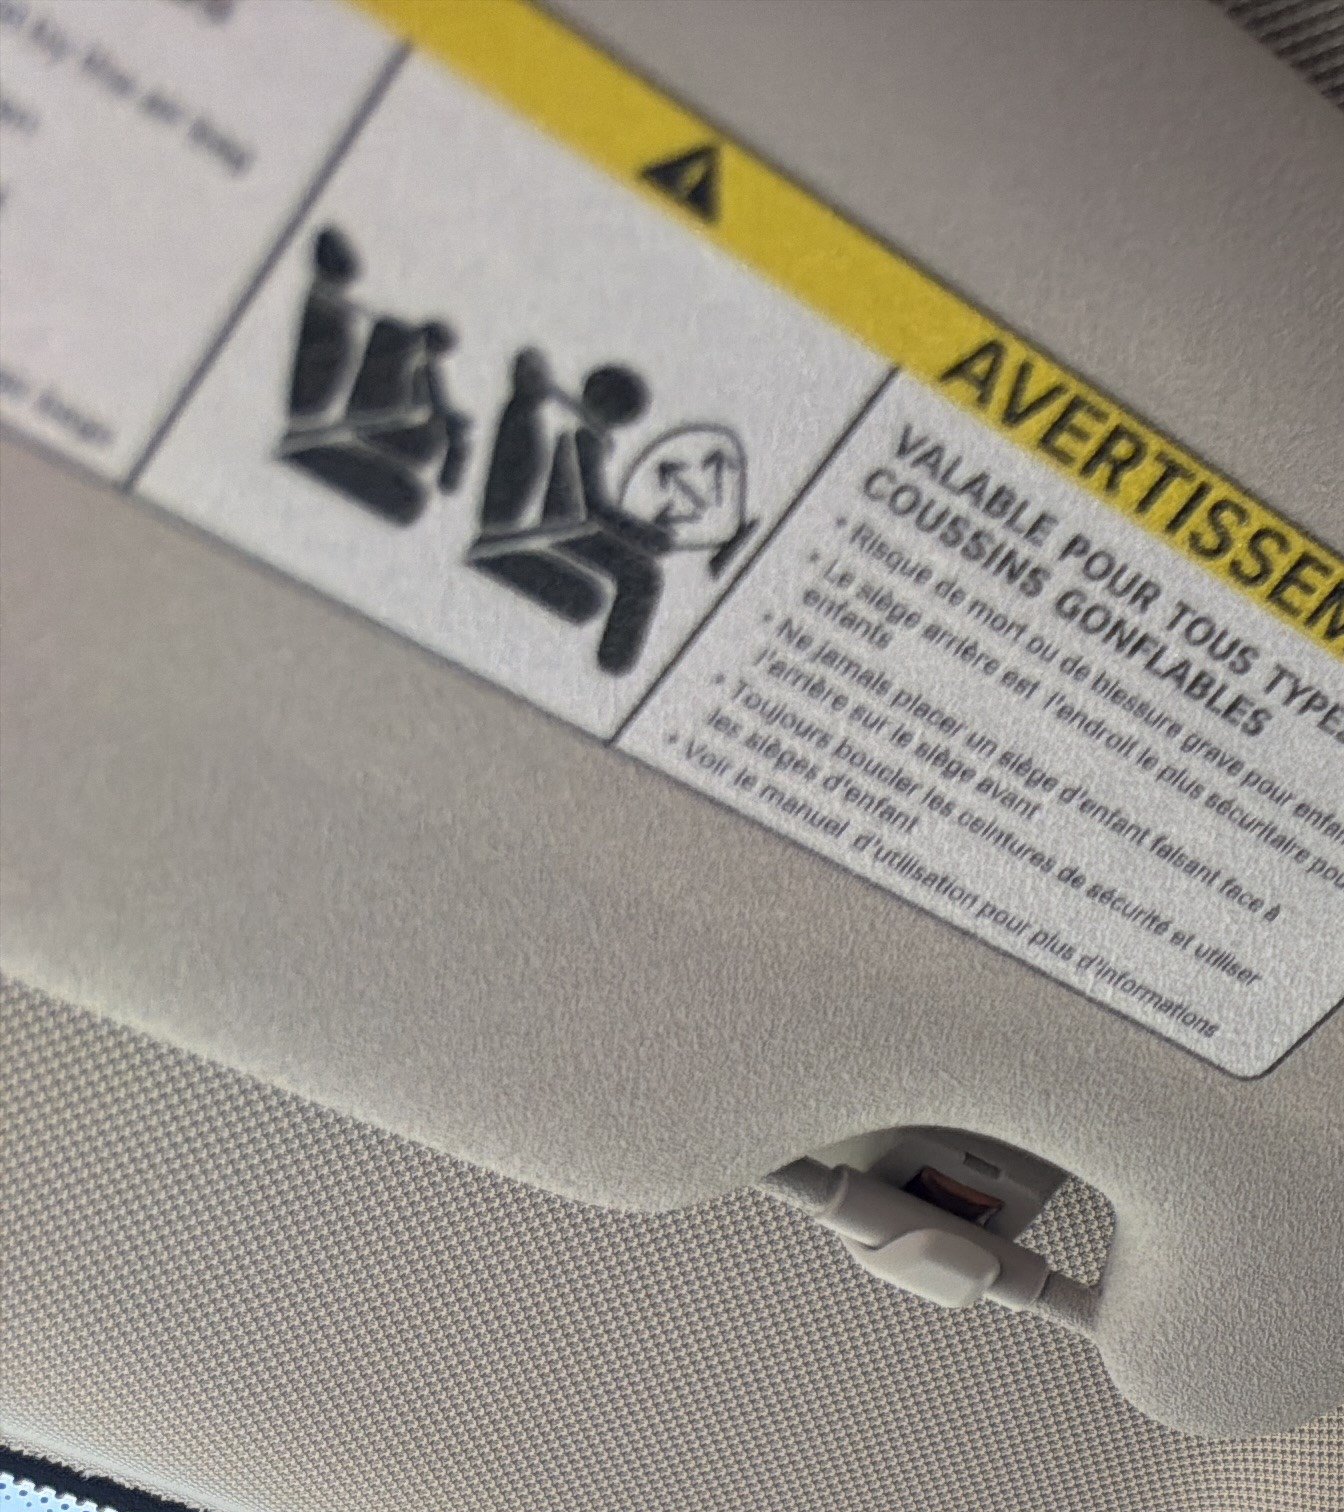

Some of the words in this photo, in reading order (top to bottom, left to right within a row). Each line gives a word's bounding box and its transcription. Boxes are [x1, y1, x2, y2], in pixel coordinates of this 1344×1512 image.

[802, 588, 892, 649] enfants
[849, 521, 933, 585] Risque
[934, 579, 966, 606] de
[967, 599, 1028, 642] mort
[1025, 635, 1059, 663] ou
[1059, 656, 1091, 682] de
[1090, 671, 1183, 738] blessure
[1179, 733, 1245, 777] grave
[1239, 769, 1294, 806] pour
[863, 468, 1050, 597] COUSSINS
[1054, 589, 1272, 737] GONFLABLES
[895, 425, 1057, 546] VALABLE
[1058, 533, 1161, 613] POUR
[1166, 600, 1259, 675] TOUS
[706, 707, 742, 738] les
[743, 731, 819, 781] sièges
[821, 774, 920, 834] d'enfant
[732, 678, 833, 749] Toujours
[831, 737, 923, 796] boucler
[920, 786, 956, 818] les
[957, 810, 1056, 874] ceintures
[1056, 867, 1086, 889] de
[1085, 883, 1173, 936] sécurité
[1169, 930, 1196, 950] et
[1194, 943, 1261, 986] utiliser
[754, 648, 849, 711] l'arrière
[849, 705, 888, 733] sur
[889, 724, 913, 748] le
[913, 741, 976, 782] siège
[975, 777, 1041, 820] avant
[777, 617, 813, 651] Ne
[809, 641, 892, 696] jamais
[890, 689, 965, 737] placer
[965, 732, 998, 758] un
[997, 750, 1059, 792] siège
[1058, 785, 1151, 847] d'enfant
[1149, 834, 1222, 887] faisant
[1218, 877, 1265, 913] face
[1262, 904, 1281, 923] à
[823, 560, 855, 588] Le
[855, 582, 922, 628] siège
[921, 623, 1000, 676] arrière
[1000, 670, 1041, 700] est
[1043, 691, 1140, 758] l'endroit
[1136, 747, 1159, 770] le
[1155, 764, 1205, 800] plus
[1204, 792, 1311, 864] sécuritaire
[685, 739, 732, 776] Voir
[733, 767, 758, 790] le
[759, 783, 850, 839] manuel
[851, 834, 979, 908] d'utilisation
[974, 901, 1032, 936] pour
[1027, 928, 1076, 962] plus
[1076, 954, 1220, 1039] d'informations
